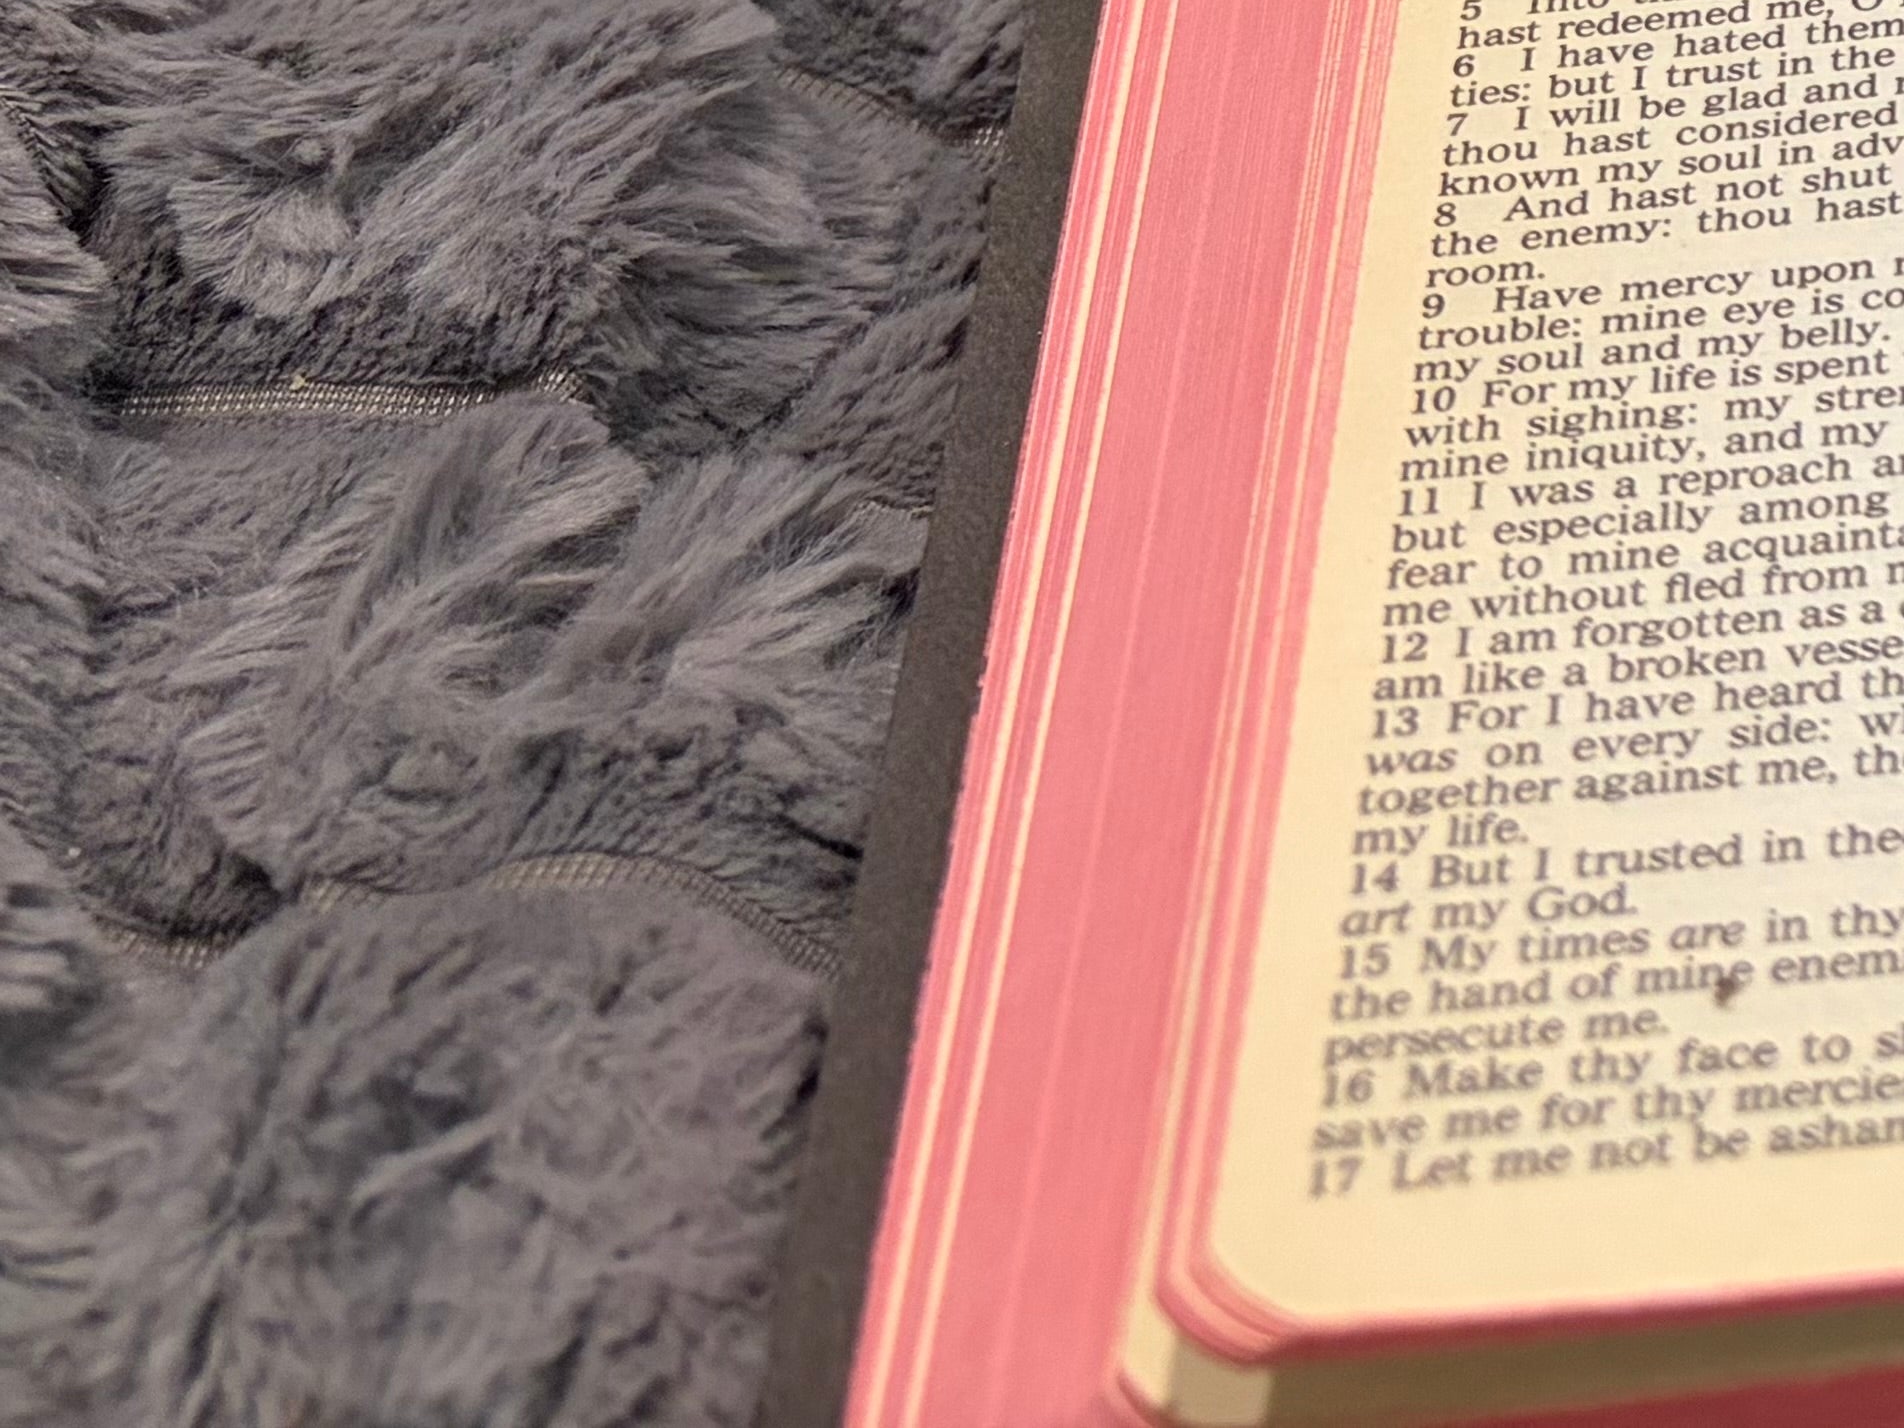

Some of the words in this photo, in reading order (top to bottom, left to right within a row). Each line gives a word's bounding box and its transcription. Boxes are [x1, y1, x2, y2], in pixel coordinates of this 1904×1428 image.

[1421, 292, 1445, 319] 9
[1491, 283, 1602, 313] Have
[1619, 270, 1752, 302] mercy
[1769, 258, 1874, 289] upon
[1349, 860, 1399, 896] 14
[1427, 852, 1510, 890] But
[1533, 846, 1549, 882] I
[1573, 831, 1743, 879] trusted
[1761, 828, 1805, 864] in
